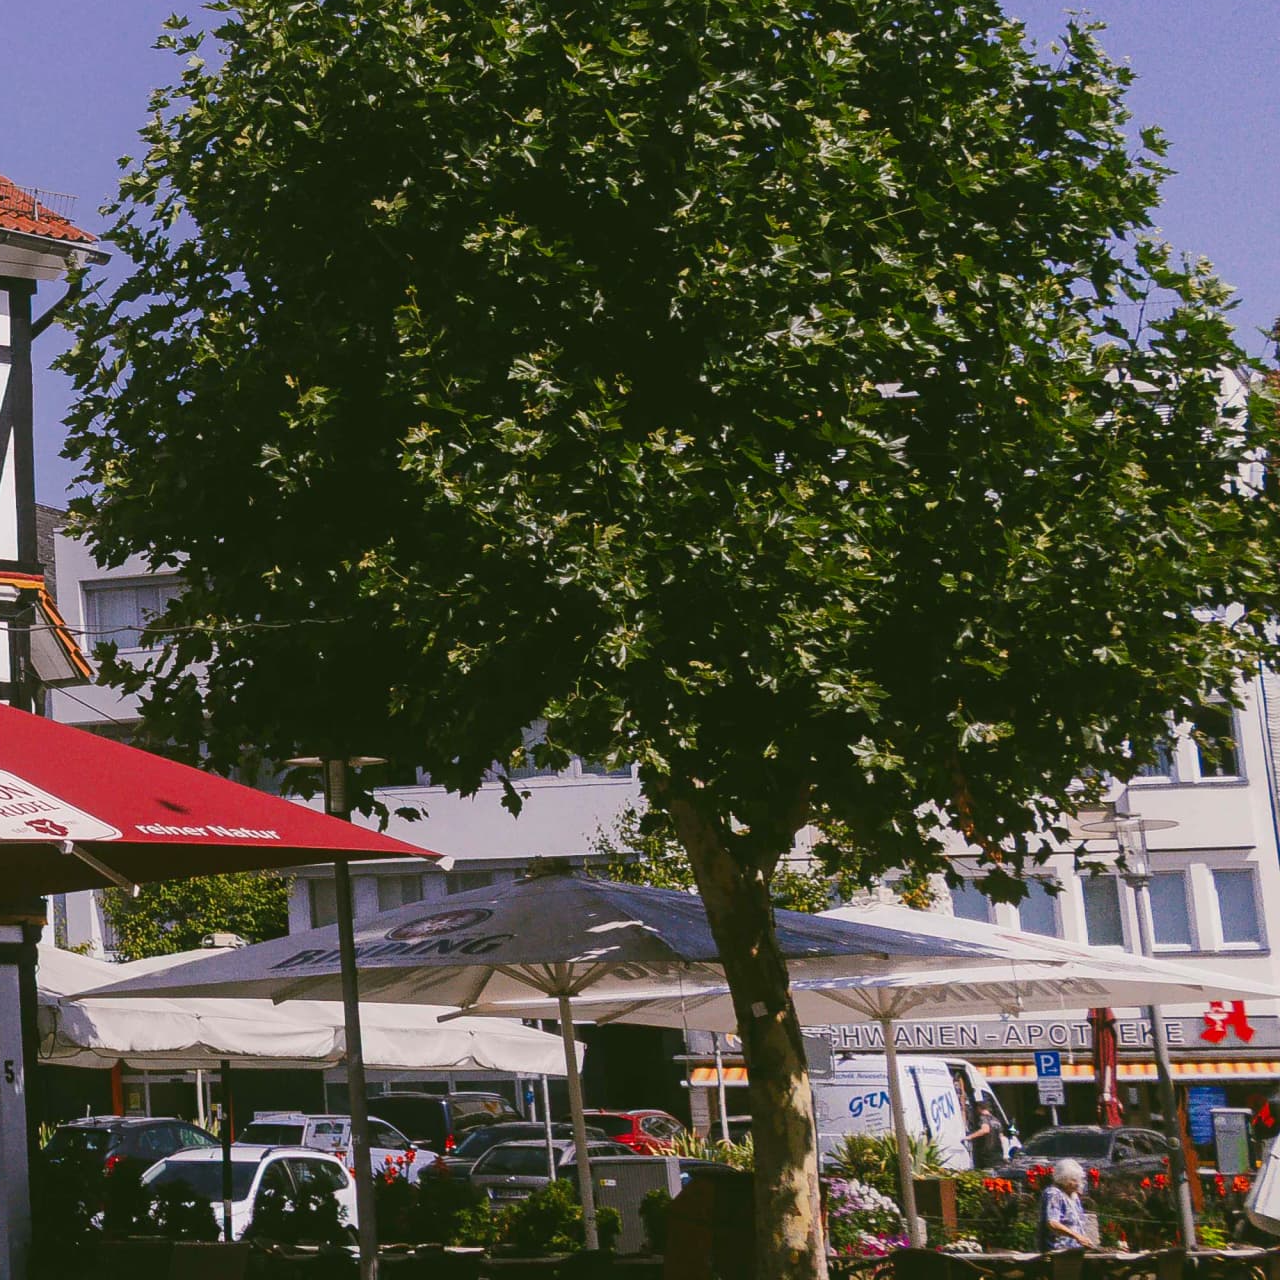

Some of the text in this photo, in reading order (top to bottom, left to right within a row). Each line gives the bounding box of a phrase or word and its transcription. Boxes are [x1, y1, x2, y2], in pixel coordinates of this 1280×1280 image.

[135, 821, 210, 838] reiner
[203, 824, 281, 841] Natur
[4, 1059, 16, 1084] 5
[1040, 1054, 1055, 1074] P
